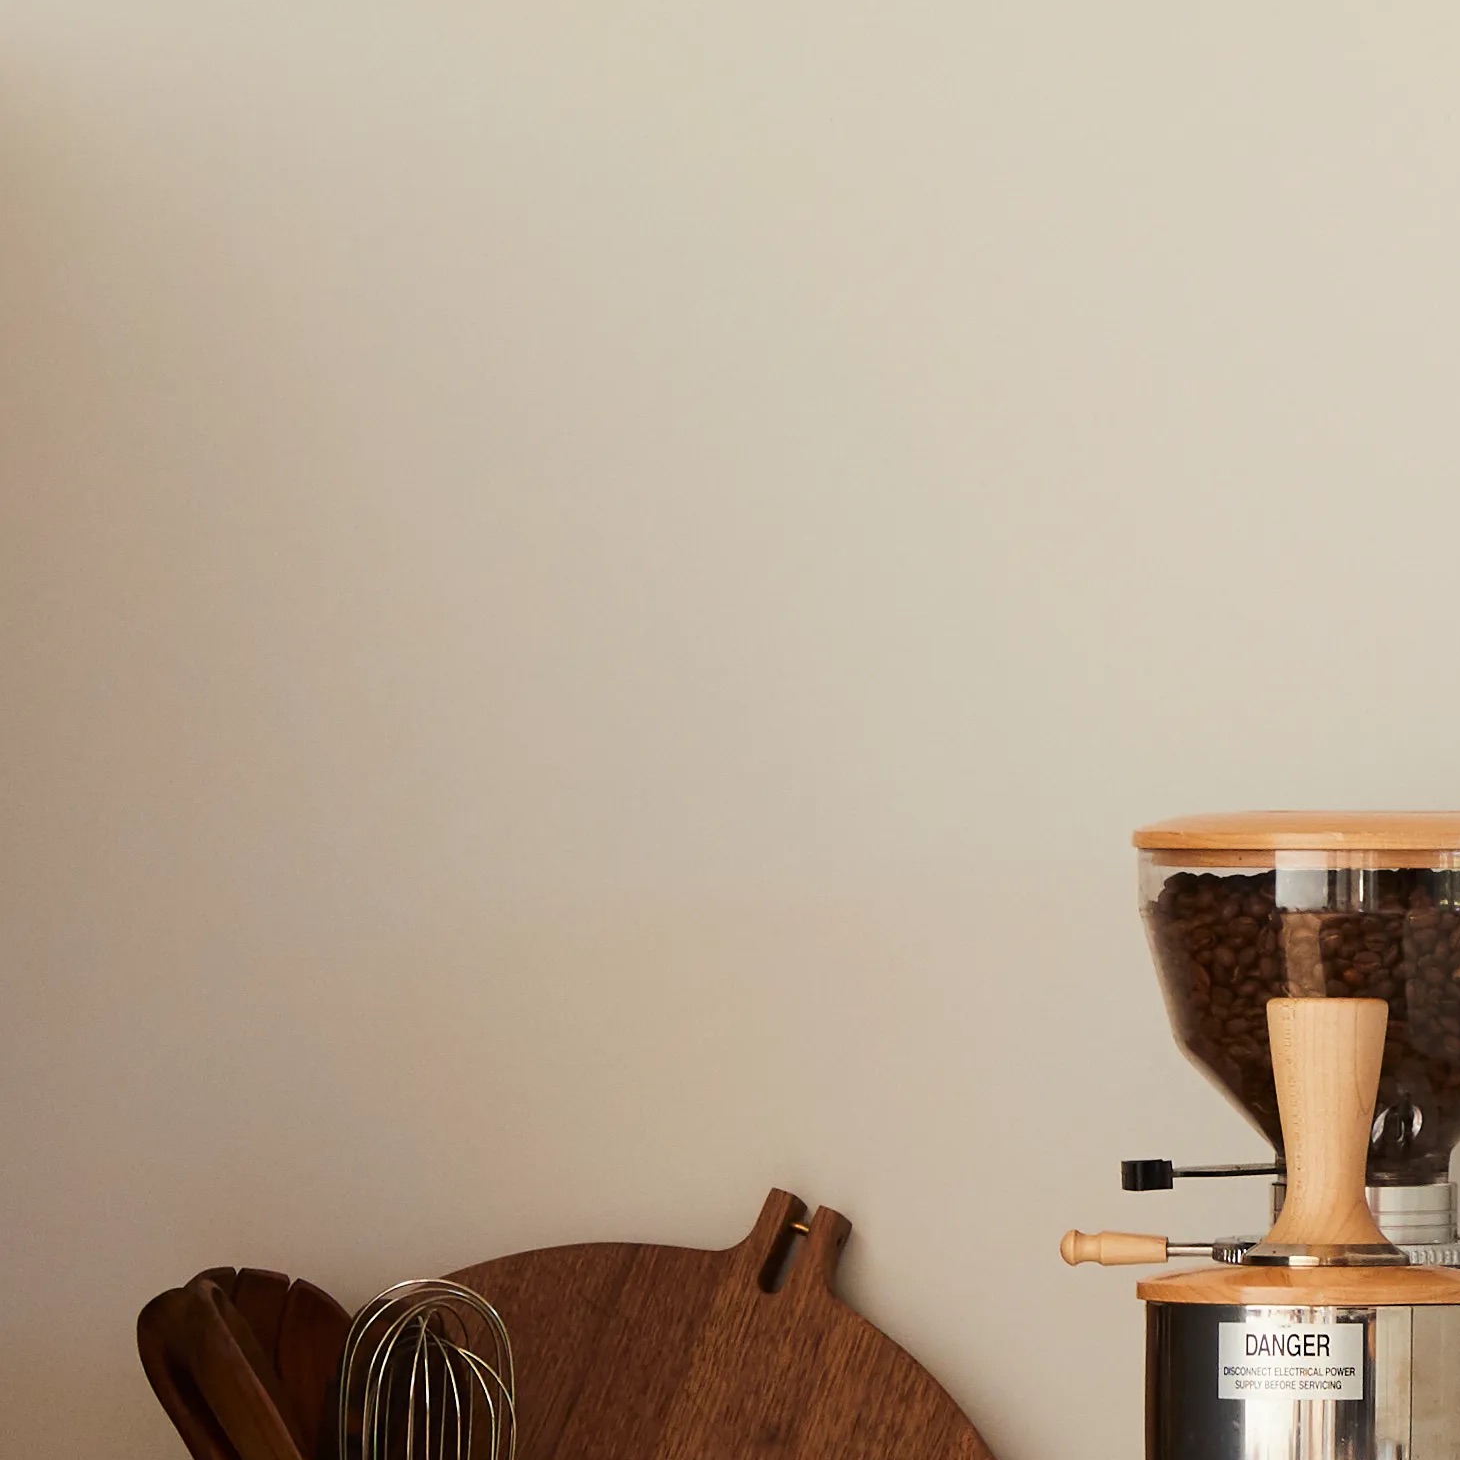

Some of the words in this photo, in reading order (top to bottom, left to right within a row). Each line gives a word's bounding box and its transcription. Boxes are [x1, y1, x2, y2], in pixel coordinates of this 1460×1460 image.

[1245, 1333, 1331, 1357] DANGER
[1223, 1366, 1271, 1376] DISCONNECT
[1274, 1366, 1322, 1377] ELECTRICAL
[1325, 1366, 1356, 1377] POWER
[1235, 1379, 1262, 1390] SUPPLY
[1265, 1380, 1296, 1390] BEFORE
[1299, 1380, 1342, 1390] SERVICING
